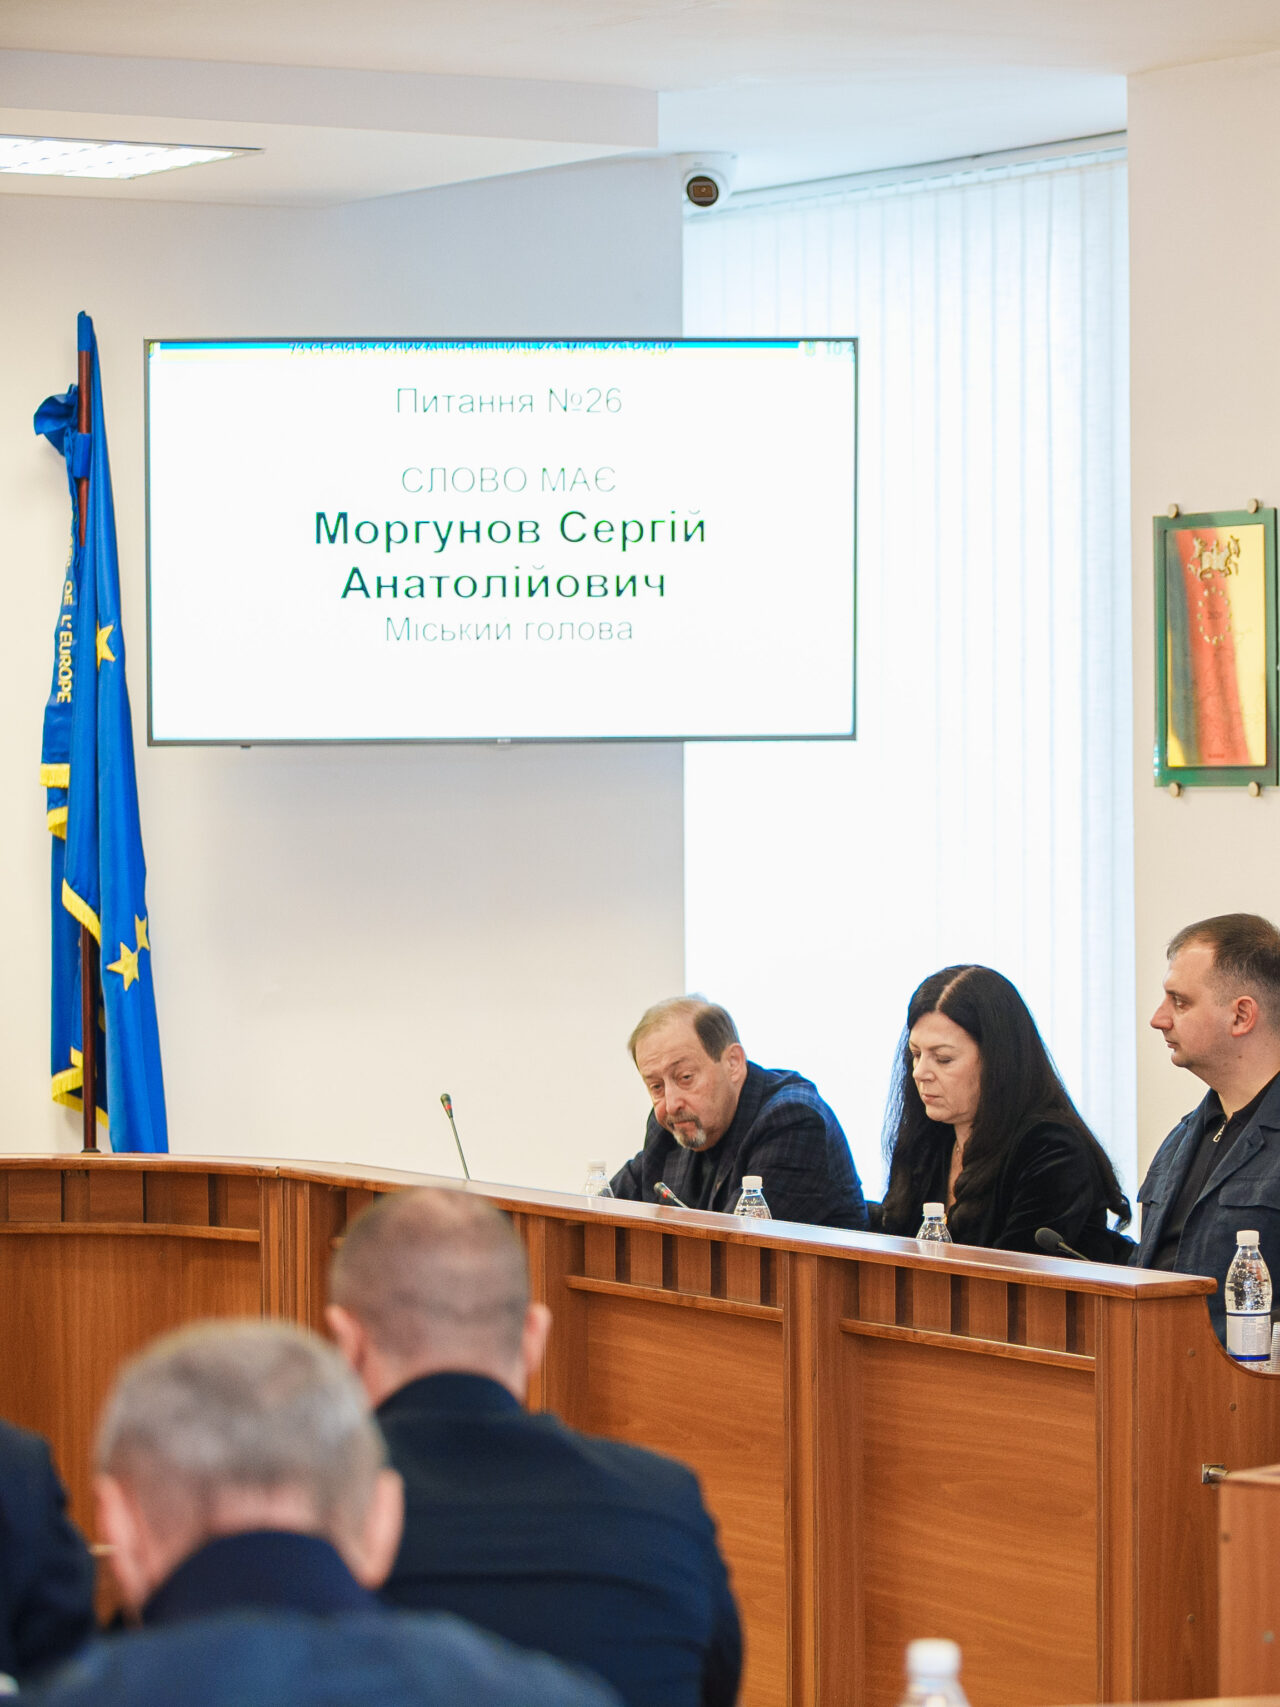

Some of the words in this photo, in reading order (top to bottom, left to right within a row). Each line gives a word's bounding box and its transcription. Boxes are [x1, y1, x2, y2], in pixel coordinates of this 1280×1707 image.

[398, 389, 532, 413] Питання
[550, 388, 621, 412] №26
[401, 467, 526, 492] СЛОВО
[542, 467, 615, 491] МАЄ
[315, 512, 540, 553] Моргунов
[560, 510, 705, 551] Сергій
[341, 566, 665, 599] Анатолійович
[526, 622, 631, 640] голова
